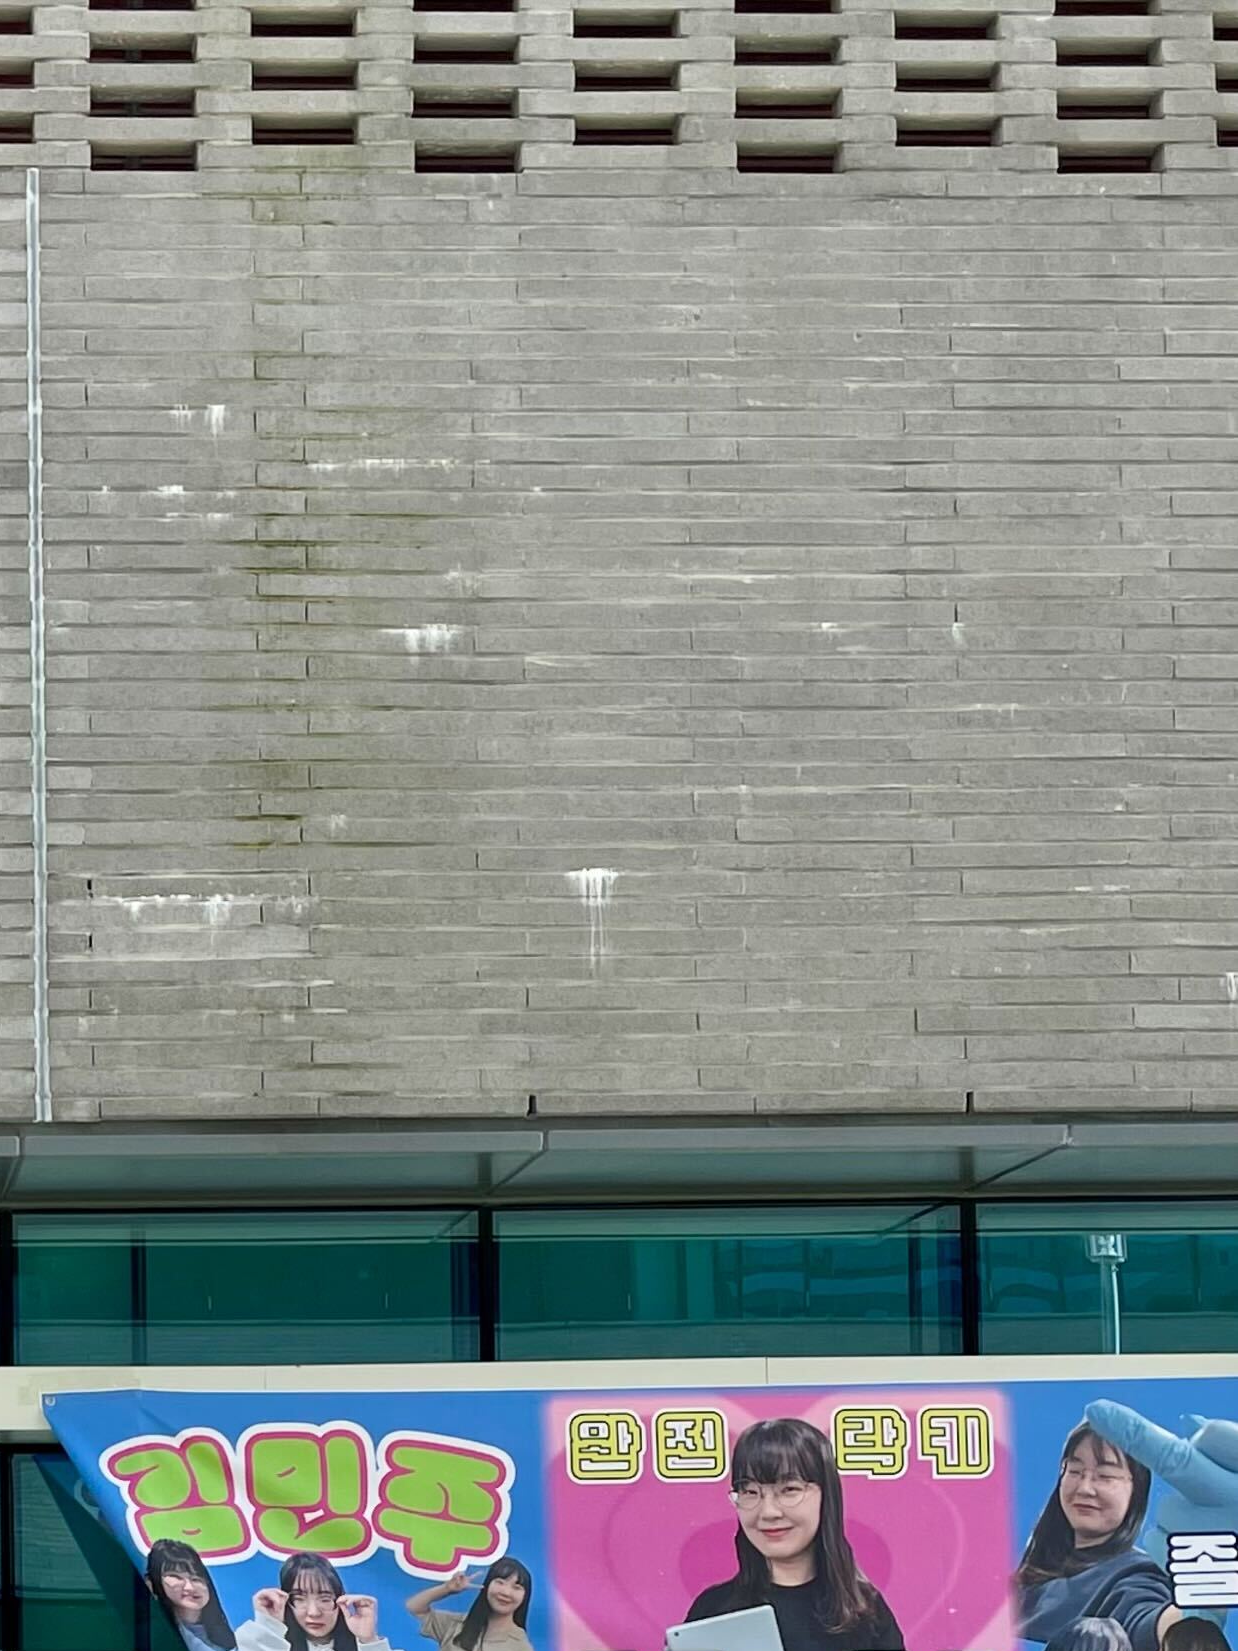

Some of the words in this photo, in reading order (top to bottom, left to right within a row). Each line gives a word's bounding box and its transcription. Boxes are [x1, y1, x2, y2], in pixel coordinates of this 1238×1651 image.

[570, 1412, 726, 1481] 완전
[834, 1408, 990, 1475] 락키
[105, 1426, 510, 1575] 김민주
